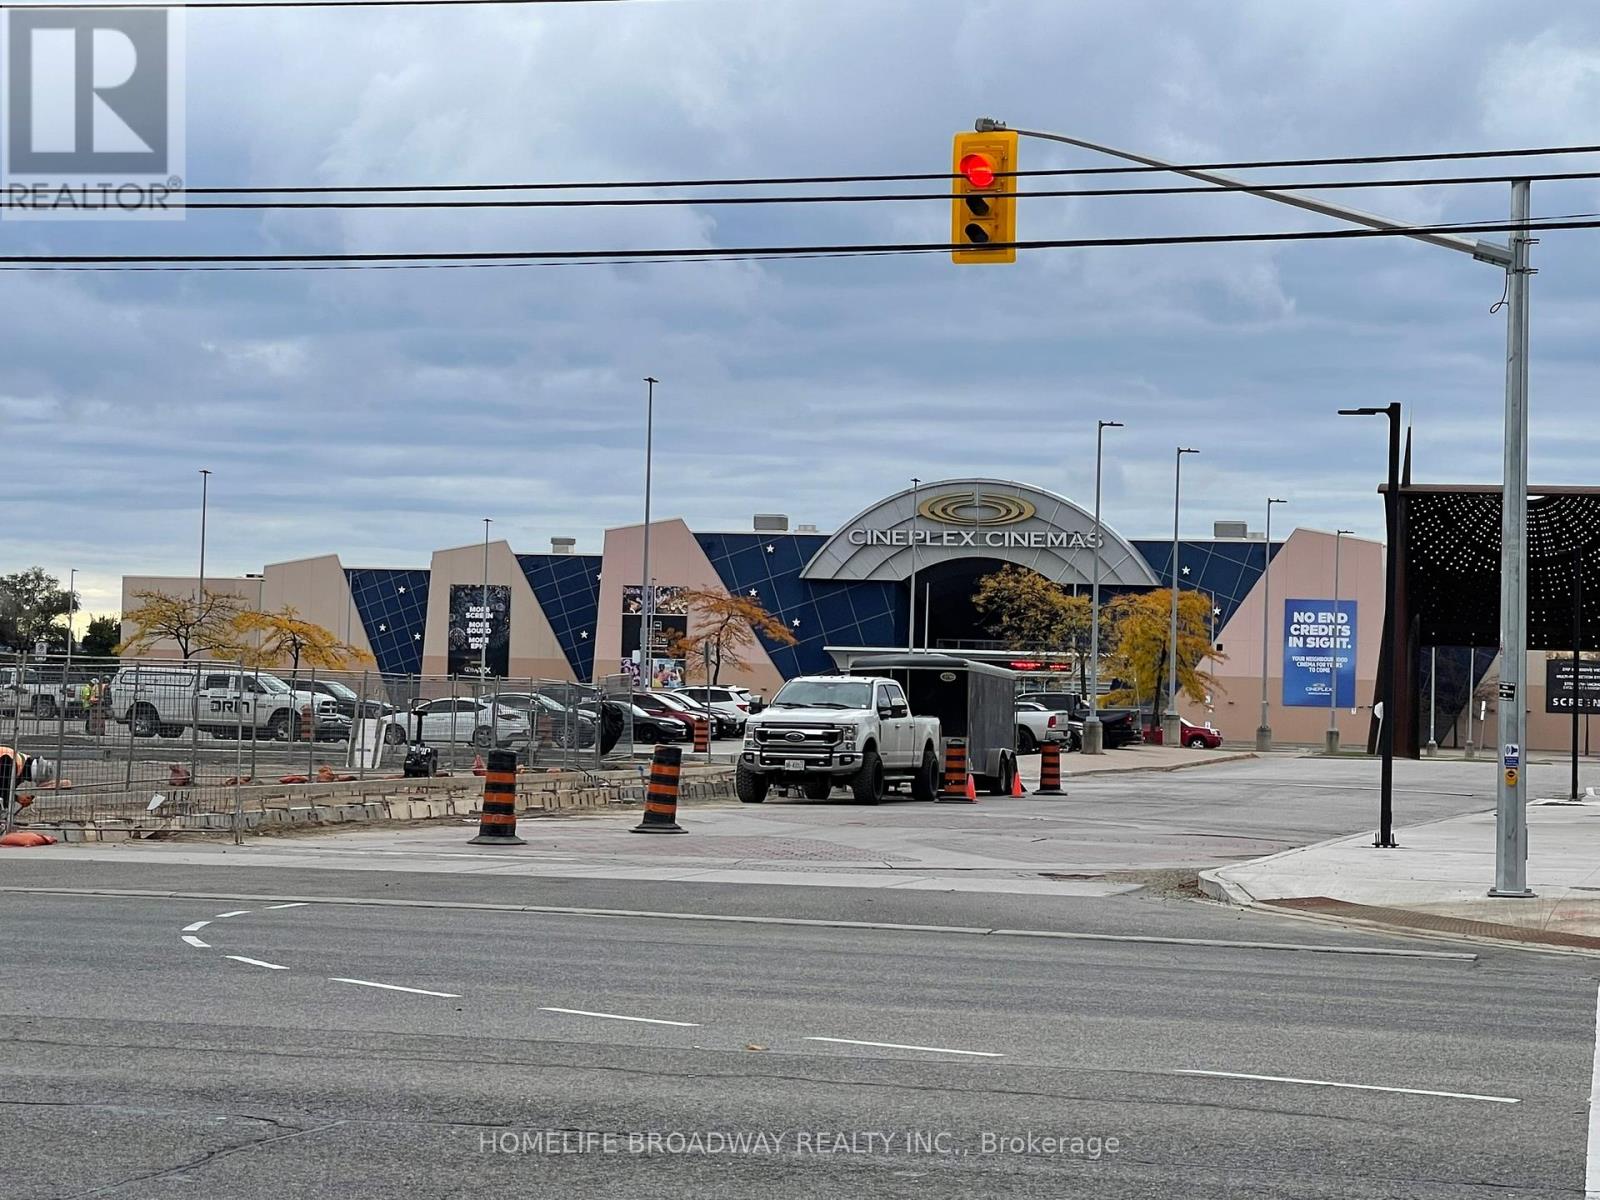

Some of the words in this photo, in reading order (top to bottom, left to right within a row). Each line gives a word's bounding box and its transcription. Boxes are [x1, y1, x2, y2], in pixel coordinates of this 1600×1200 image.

[848, 529, 976, 546] CINEPLEX
[985, 531, 1103, 548] CINEMAS
[1294, 612, 1315, 623] NO
[1318, 612, 1348, 623] END
[1290, 624, 1350, 636] CREDITS
[1289, 637, 1303, 648] IN
